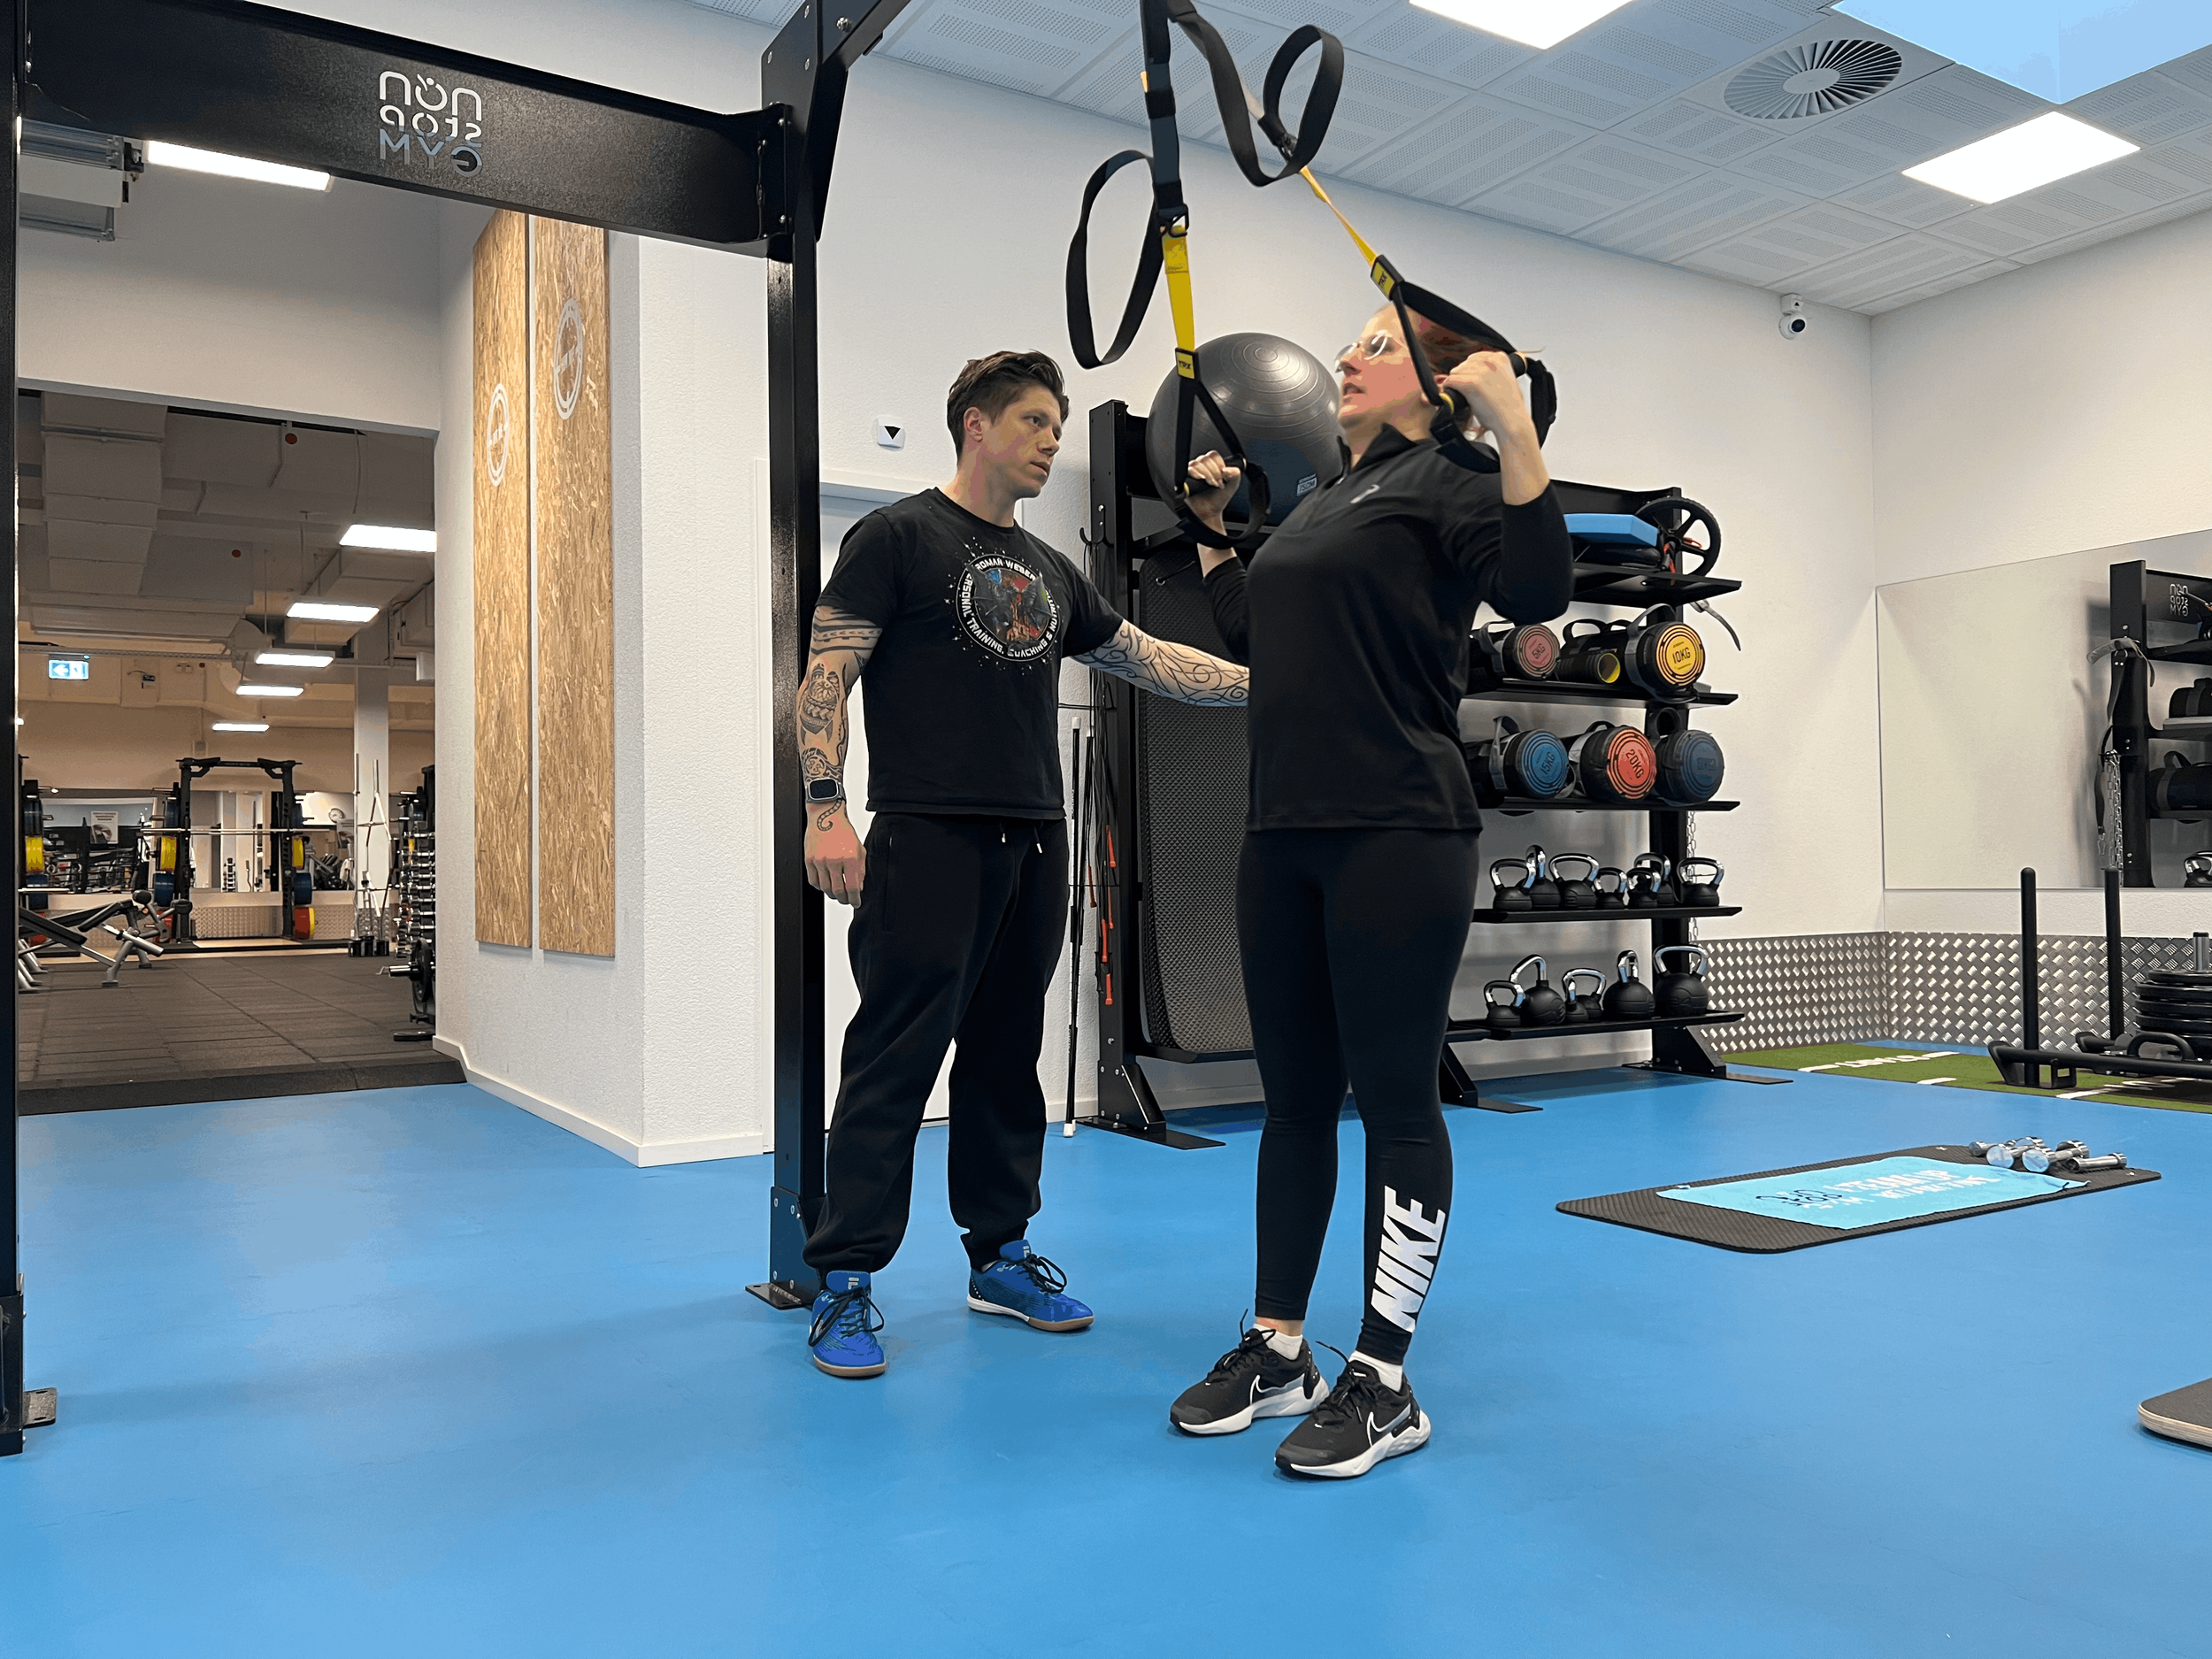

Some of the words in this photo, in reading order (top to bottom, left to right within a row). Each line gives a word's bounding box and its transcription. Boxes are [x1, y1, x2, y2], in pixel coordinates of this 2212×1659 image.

[974, 557, 1003, 570] ROMAN
[1005, 559, 1036, 581] WEBER
[961, 572, 973, 618] ERSONAL
[1532, 643, 1546, 659] 5KG
[1672, 647, 1691, 664] 10KG
[1540, 751, 1555, 775] 15KG
[1625, 749, 1645, 779] 20KG
[1371, 1185, 1447, 1333] NIKE
